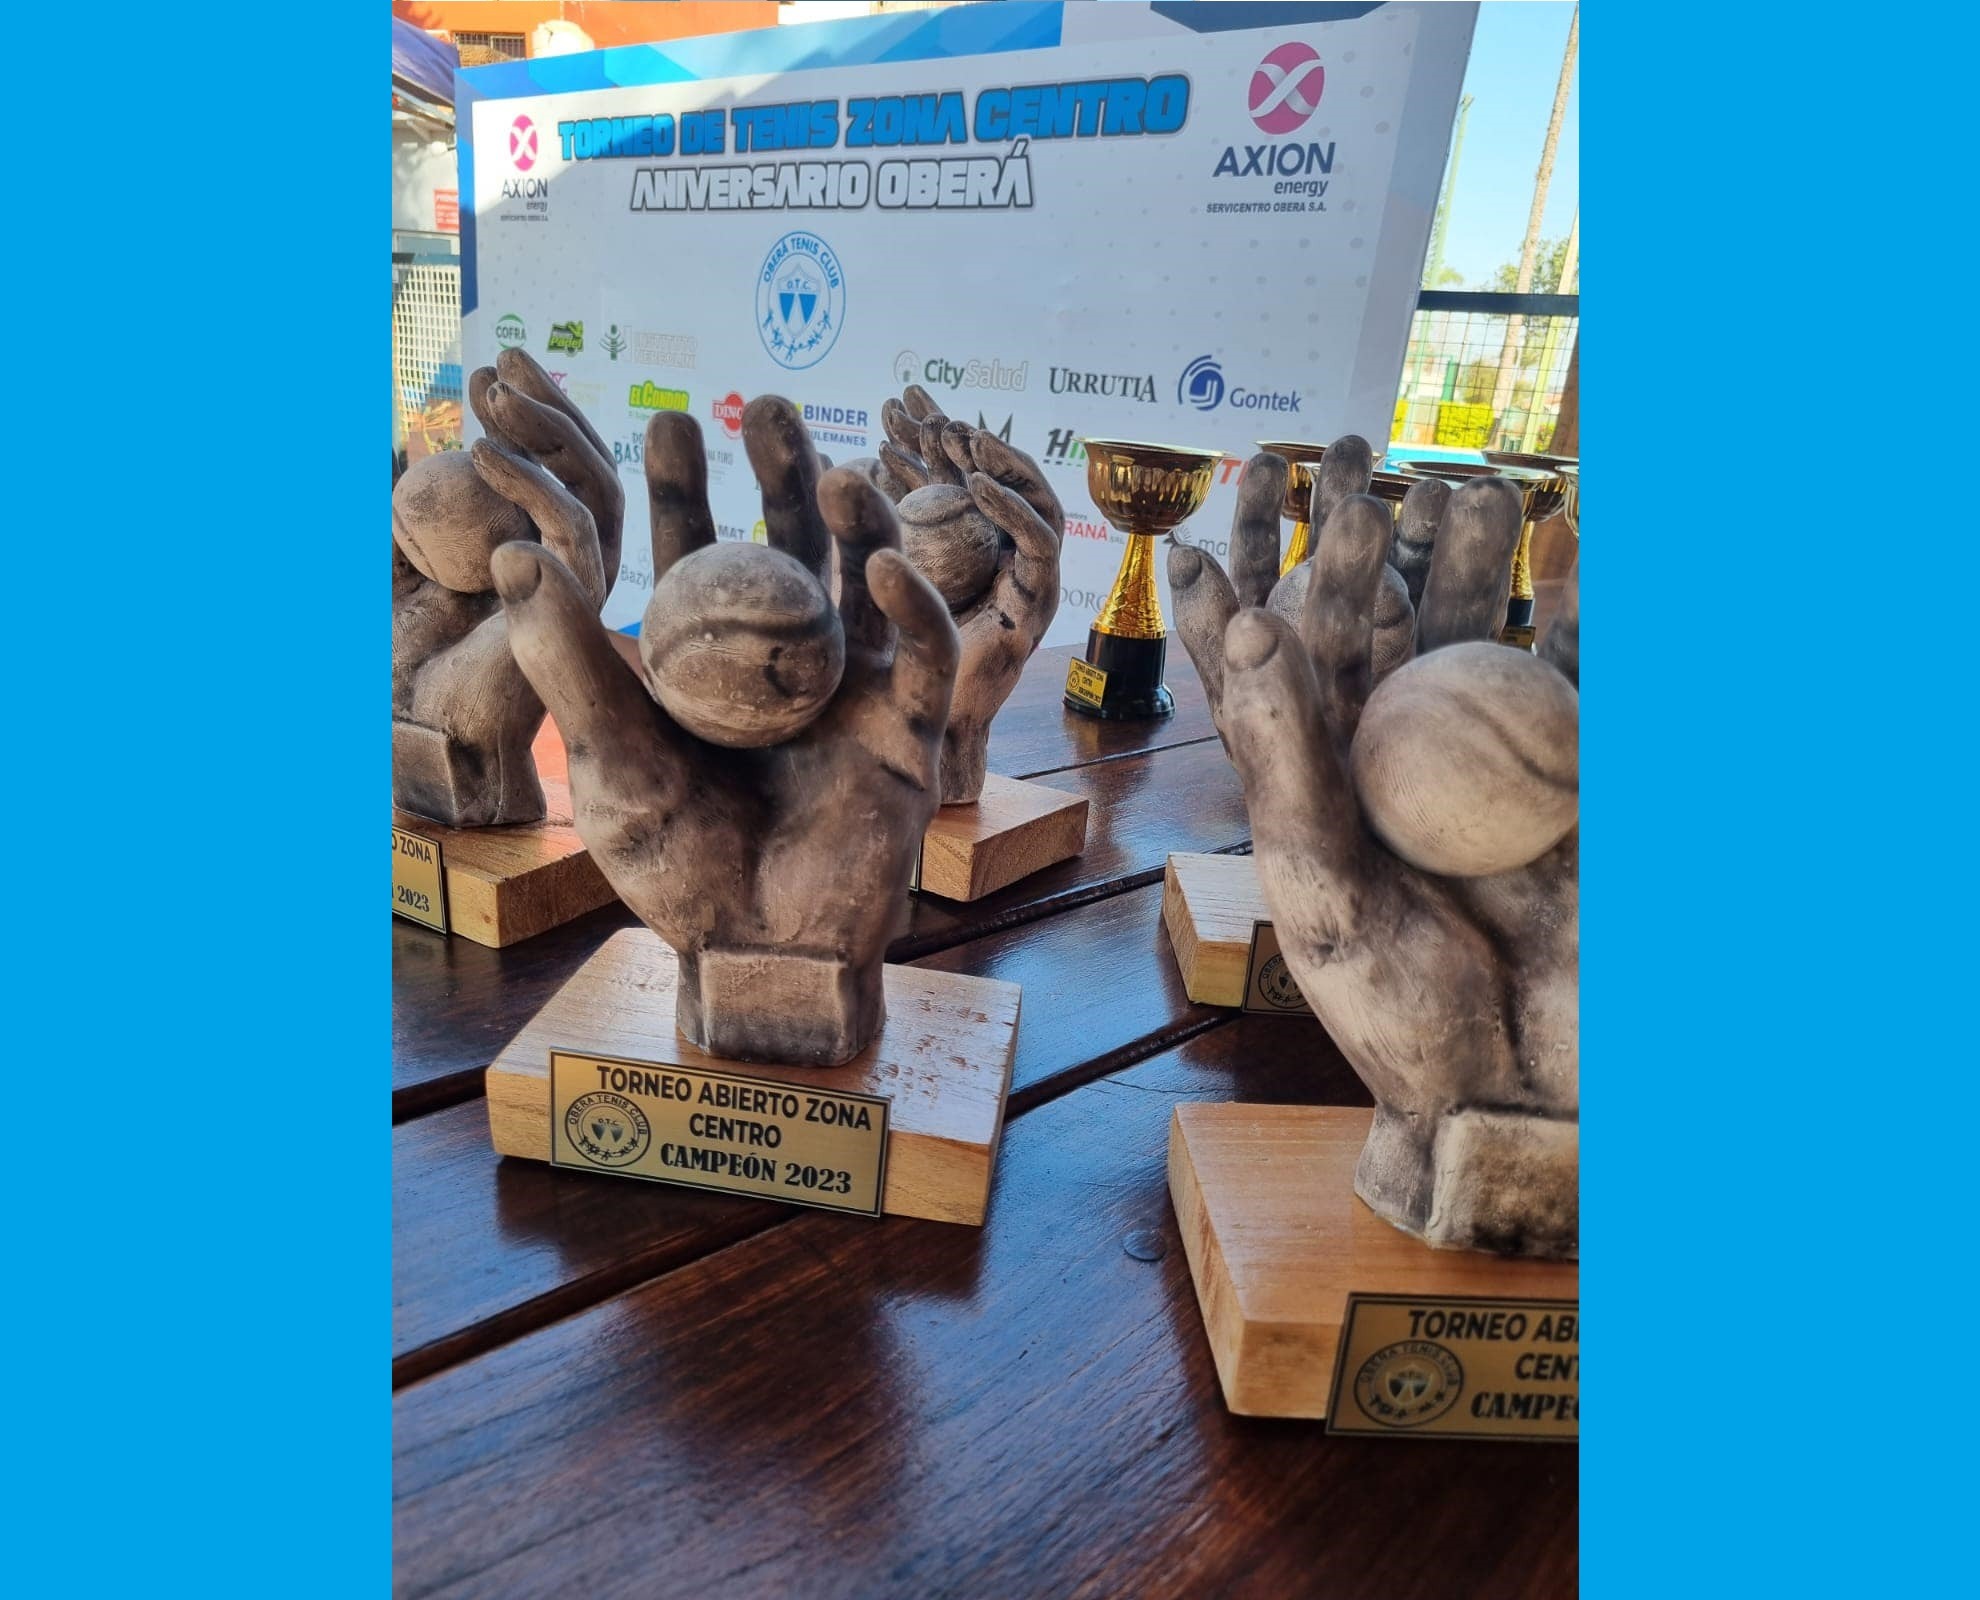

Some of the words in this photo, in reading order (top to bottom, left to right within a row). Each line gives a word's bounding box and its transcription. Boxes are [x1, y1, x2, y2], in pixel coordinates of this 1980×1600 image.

[558, 114, 675, 160] TORNEO
[679, 109, 726, 156] DE
[731, 100, 840, 153] TENIS
[845, 91, 968, 147] ZONA
[974, 74, 1190, 142] CENTRO
[1212, 142, 1336, 177] AXION
[630, 161, 871, 210] ANIVERSARIO
[877, 138, 1033, 209] OBERÁ
[502, 178, 548, 198] AXION
[1273, 180, 1329, 198] energy
[1206, 202, 1271, 213] SERVICENTRO
[1308, 201, 1327, 212] S.A.
[791, 237, 819, 255] TENIS
[820, 251, 839, 288] CLUB
[495, 326, 527, 340] COFRA
[1049, 367, 1158, 403] URRUTIA
[1229, 387, 1302, 413] Gontek
[804, 405, 868, 426] BINDER
[808, 431, 867, 447] ULEMANES
[718, 525, 745, 540] MAT
[1065, 520, 1107, 541] RANÁ
[1199, 538, 1228, 556] ma
[400, 836, 433, 864] ZONA
[397, 885, 430, 913] 2023
[596, 1094, 630, 1110] TENIS
[597, 1065, 692, 1101] TORNEO
[698, 1082, 800, 1118] ABIERTO
[805, 1098, 872, 1131] ZONA
[689, 1114, 783, 1148] CENTRO
[661, 1143, 777, 1182] CAMPEÓN
[785, 1164, 852, 1194] 2023
[1408, 1310, 1527, 1341] TORNEO
